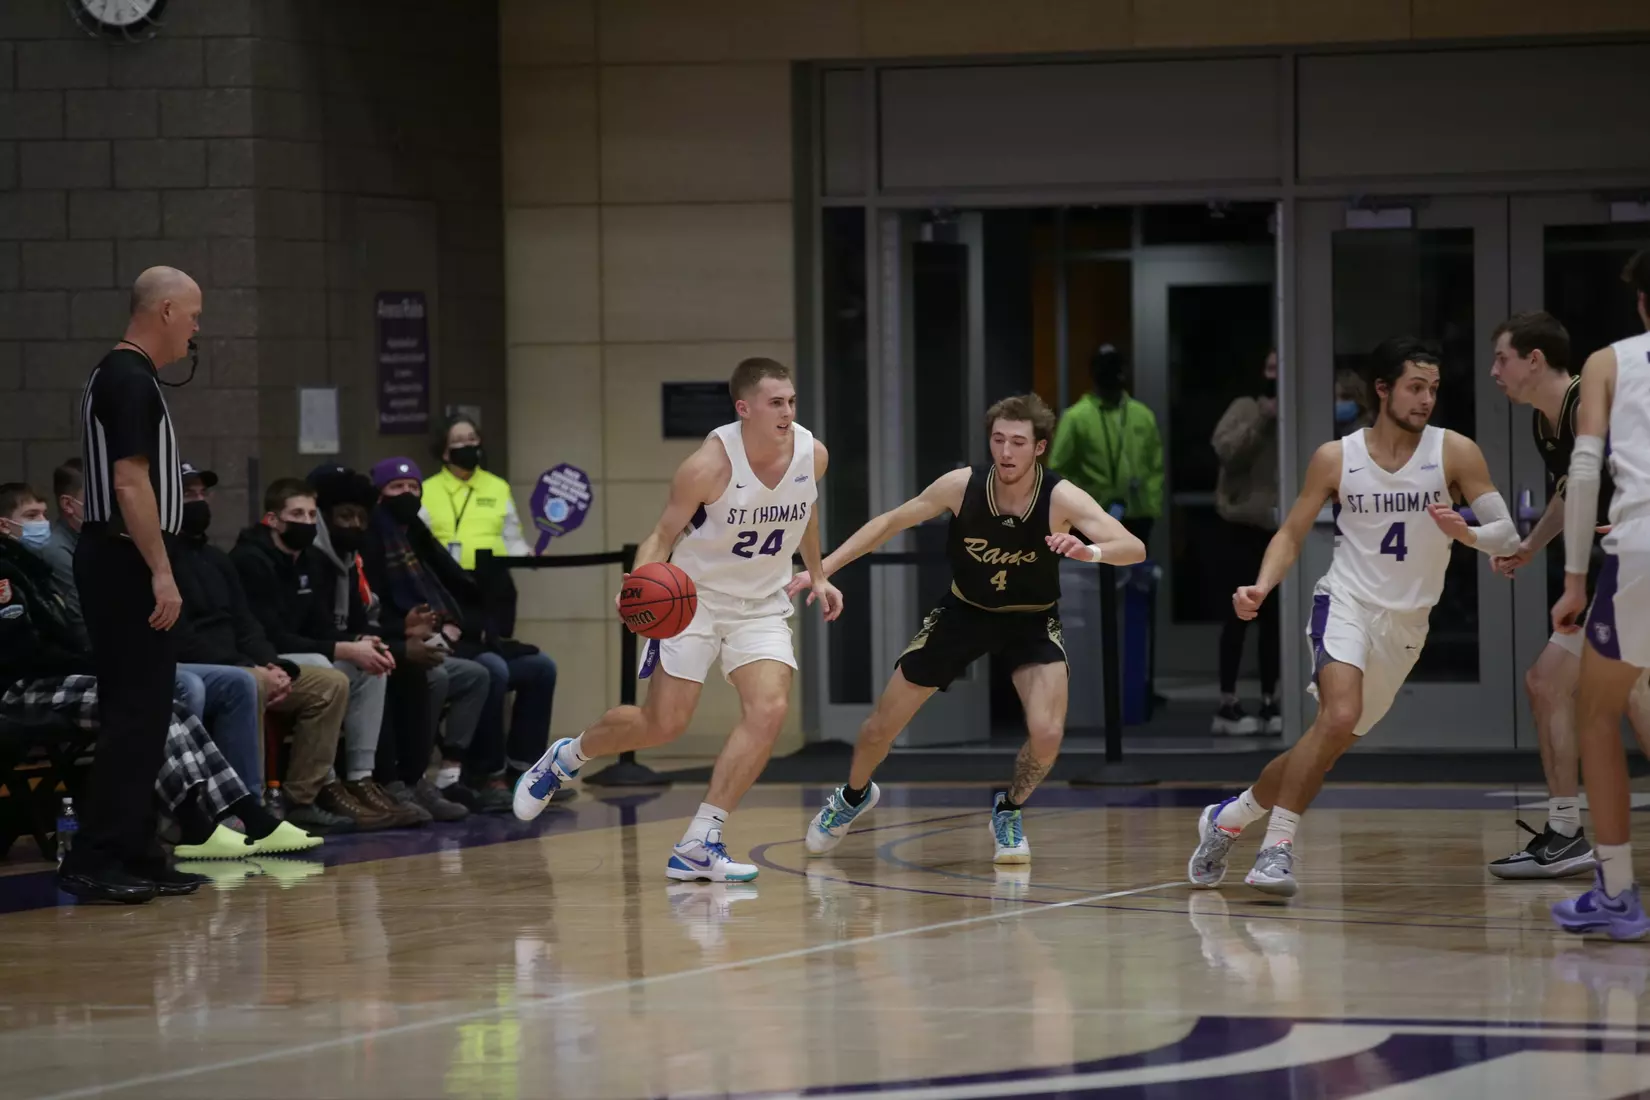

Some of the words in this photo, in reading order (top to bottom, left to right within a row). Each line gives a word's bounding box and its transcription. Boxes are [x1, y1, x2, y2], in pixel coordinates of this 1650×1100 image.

[727, 508, 747, 525] ST.
[752, 501, 807, 525] THOMAS
[1347, 494, 1368, 513] ST.
[1372, 491, 1441, 513] THOMAS
[731, 528, 785, 559] 24
[964, 538, 1038, 565] Rams
[1380, 521, 1408, 562] 4
[990, 570, 1007, 592] 4
